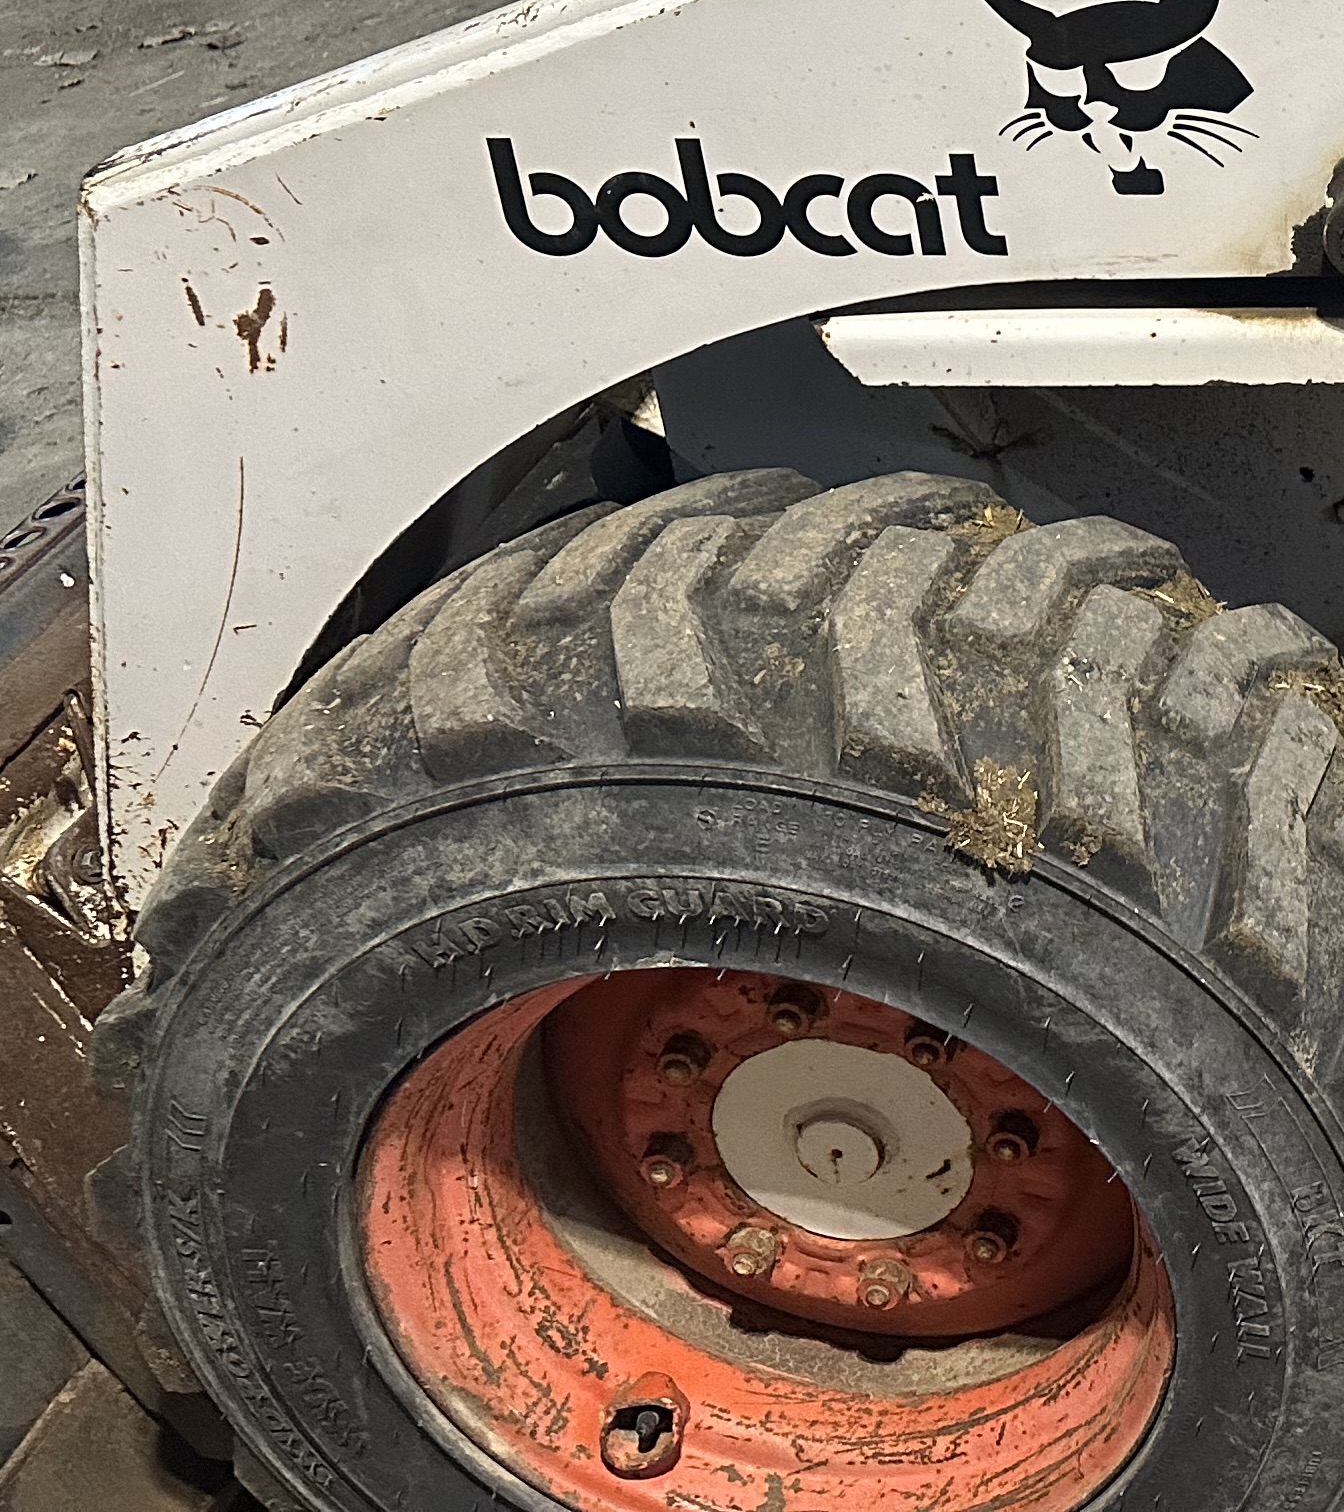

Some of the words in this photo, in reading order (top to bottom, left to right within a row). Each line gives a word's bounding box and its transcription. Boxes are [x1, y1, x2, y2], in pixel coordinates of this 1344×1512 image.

[486, 137, 1008, 258] bobcat
[505, 891, 616, 938] RIM
[628, 890, 830, 935] GUARD
[1172, 1138, 1250, 1244] WIDE
